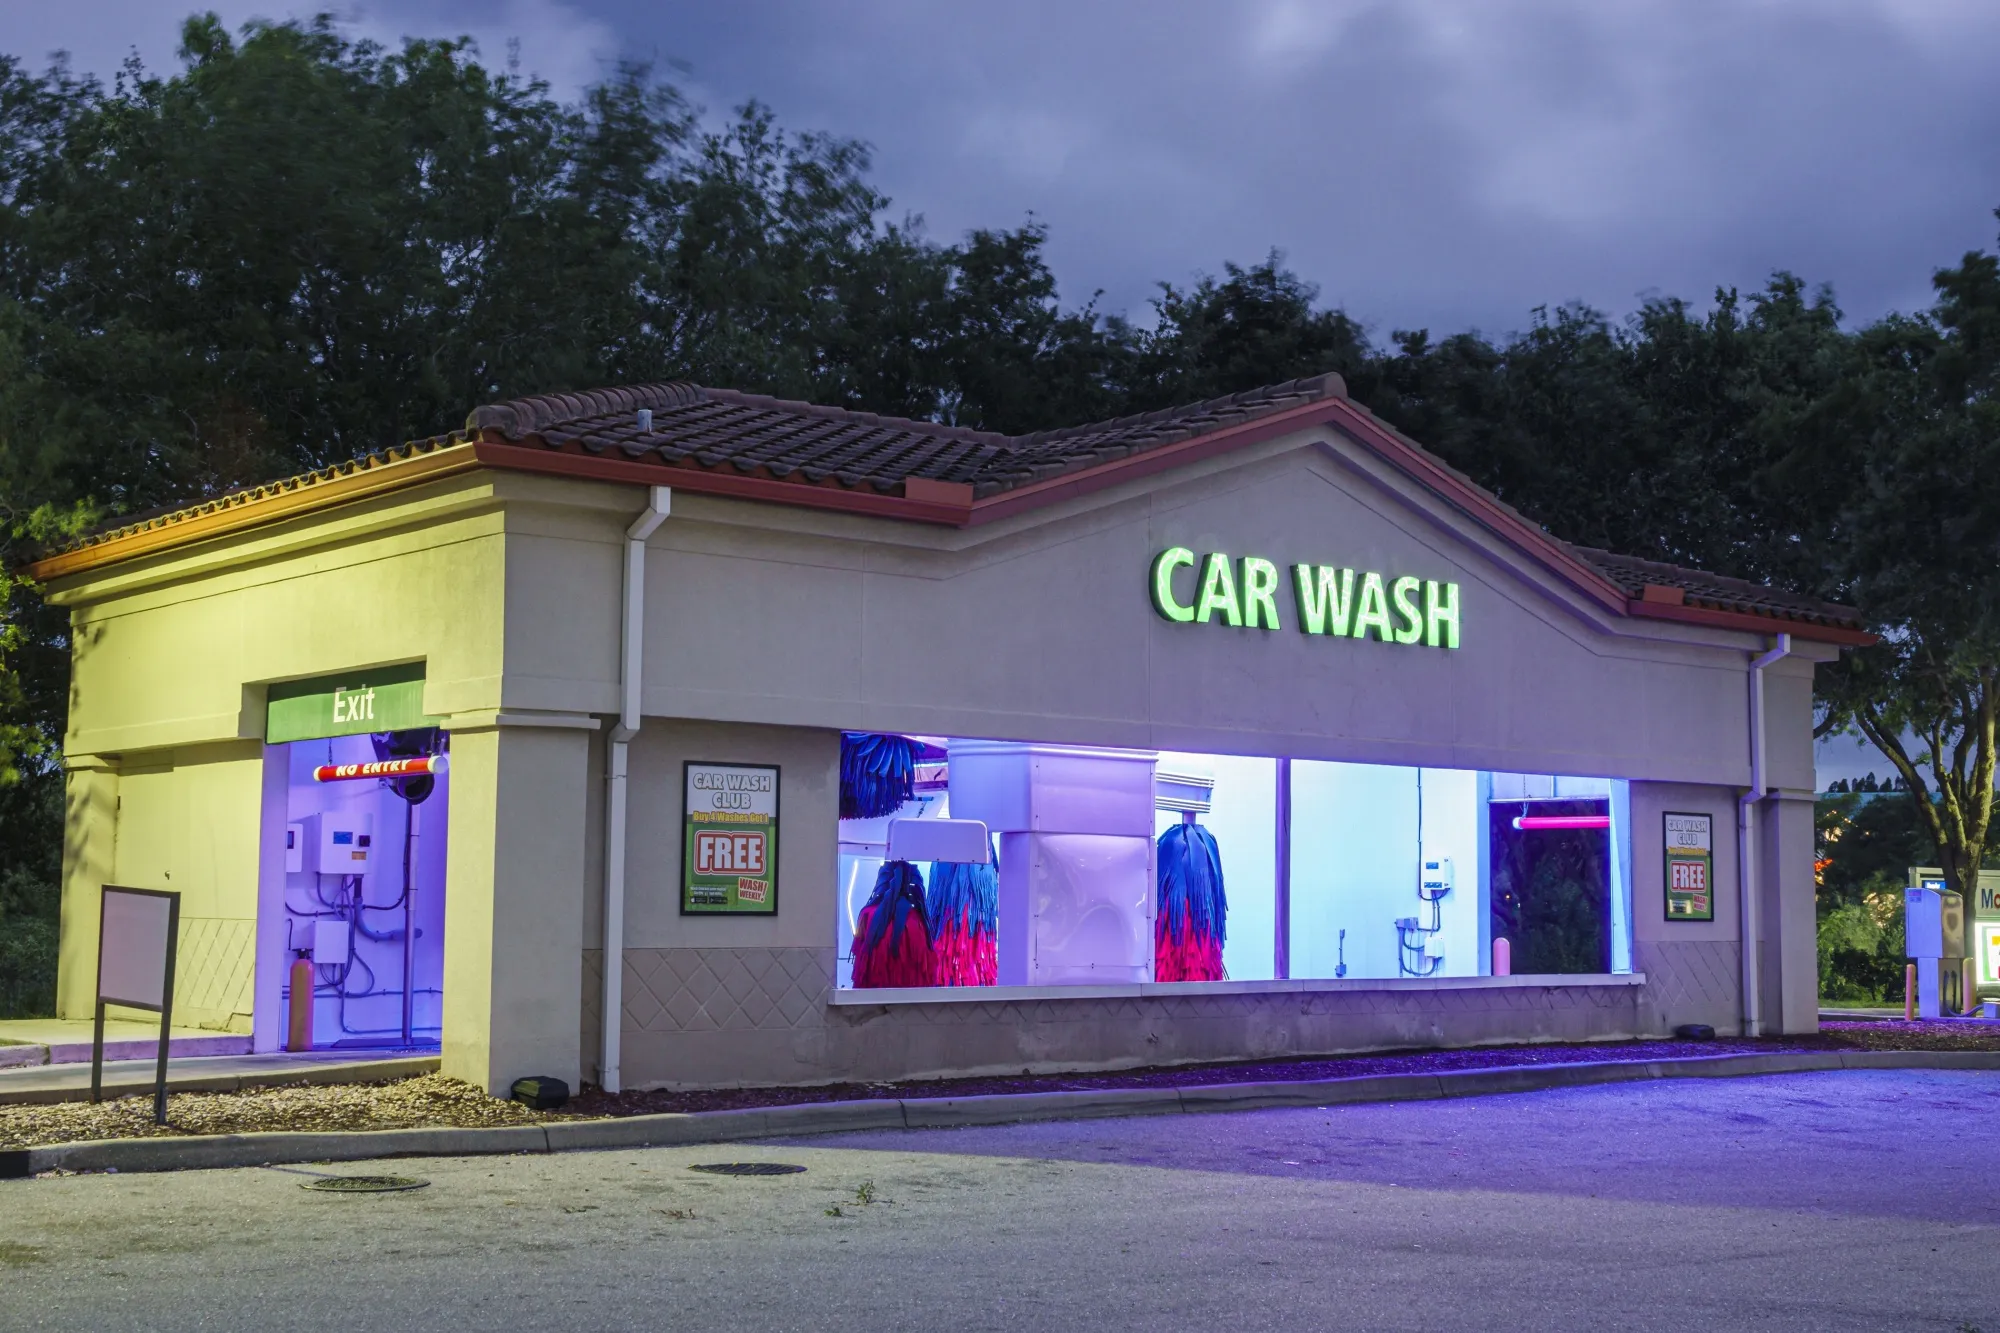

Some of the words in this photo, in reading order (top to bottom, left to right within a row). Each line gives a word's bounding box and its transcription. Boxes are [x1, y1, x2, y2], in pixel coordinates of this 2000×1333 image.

[1150, 547, 1281, 630] CAR
[1291, 563, 1460, 649] WASH
[333, 684, 375, 723] Exit
[335, 764, 357, 777] NO
[362, 759, 412, 775] ENTRY
[693, 773, 724, 790] CAR
[727, 773, 771, 792] WASH
[712, 792, 752, 809] CLUB
[693, 811, 709, 823] Buy
[717, 812, 749, 823] Washes
[1667, 820, 1683, 832] CAR
[1684, 820, 1706, 833] WASH
[1677, 833, 1697, 845] CLUB
[700, 837, 761, 869] FREE
[740, 878, 764, 892] WASH
[1672, 865, 1704, 889] FREE
